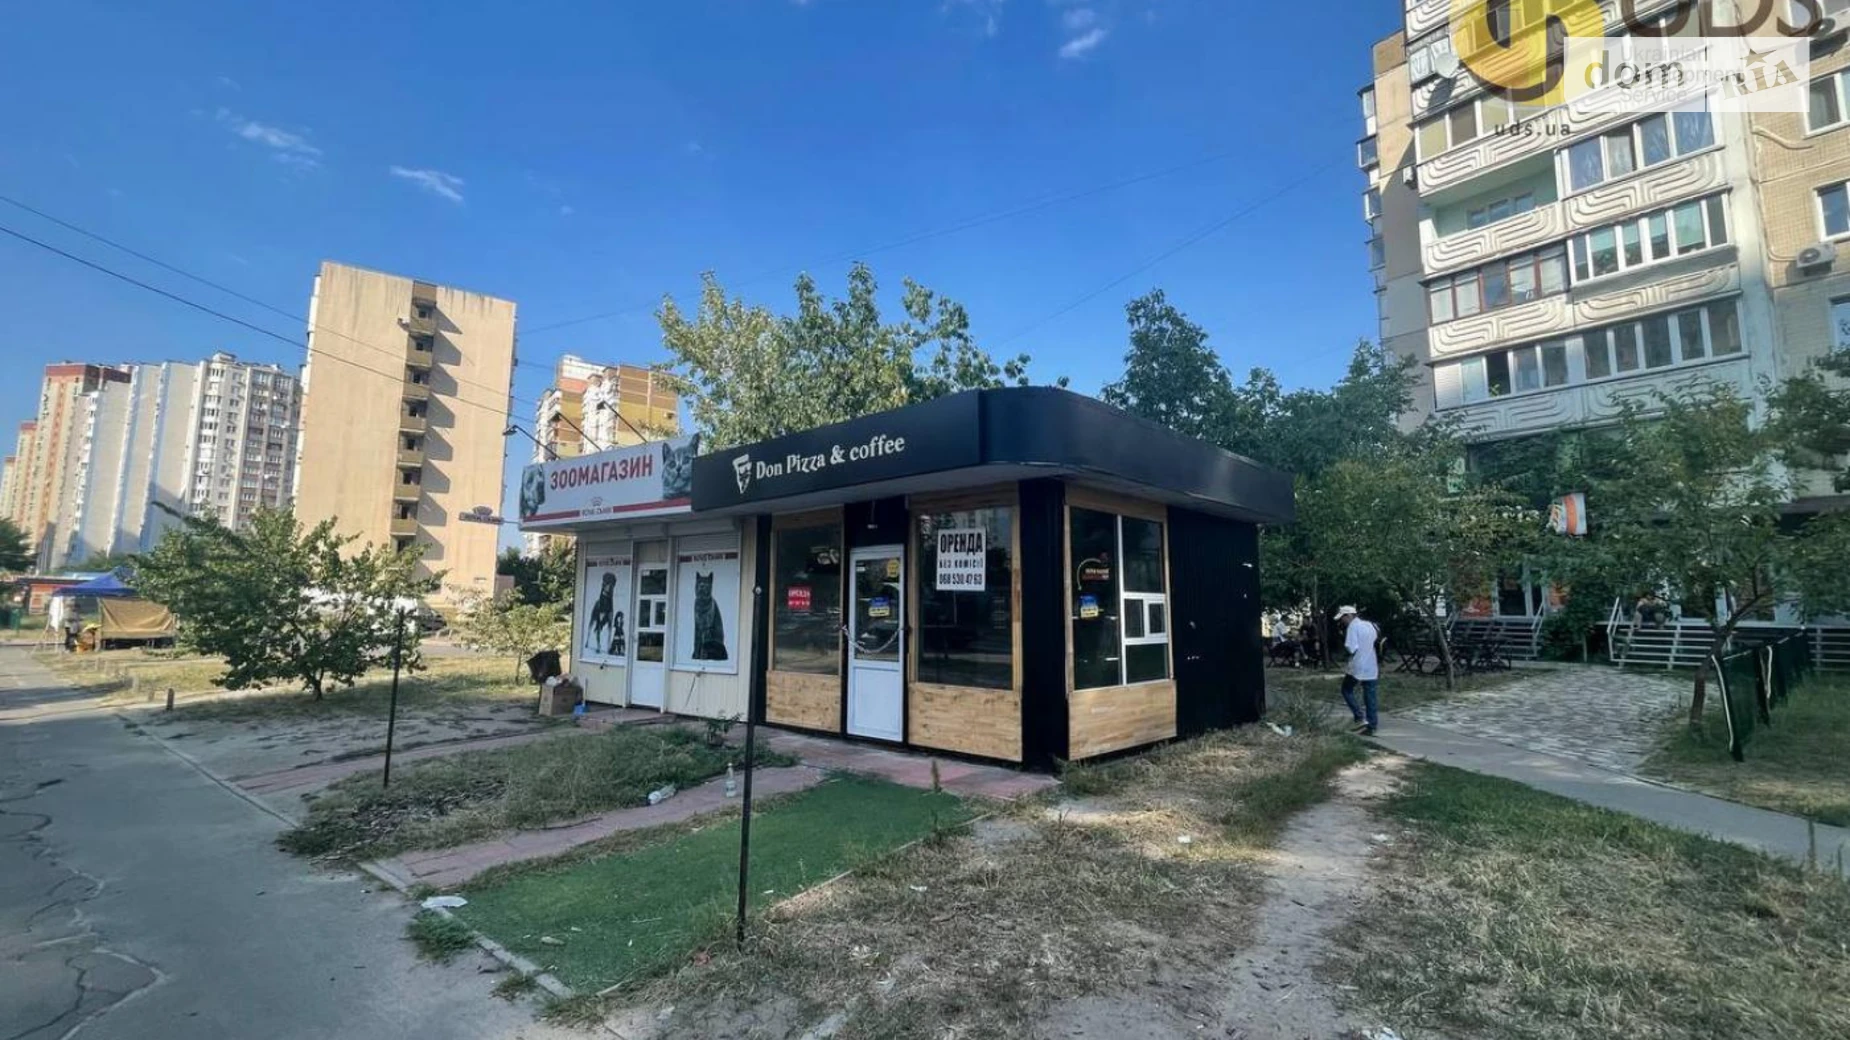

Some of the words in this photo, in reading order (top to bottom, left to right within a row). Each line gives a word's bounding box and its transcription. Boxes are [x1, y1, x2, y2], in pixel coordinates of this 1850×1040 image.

[550, 453, 653, 491] ЗООМАГАЗИН
[756, 461, 783, 479] Don
[786, 454, 826, 473] Pizza
[830, 444, 846, 465] &
[849, 434, 905, 461] coffee
[940, 533, 983, 556] ОРЕНДА
